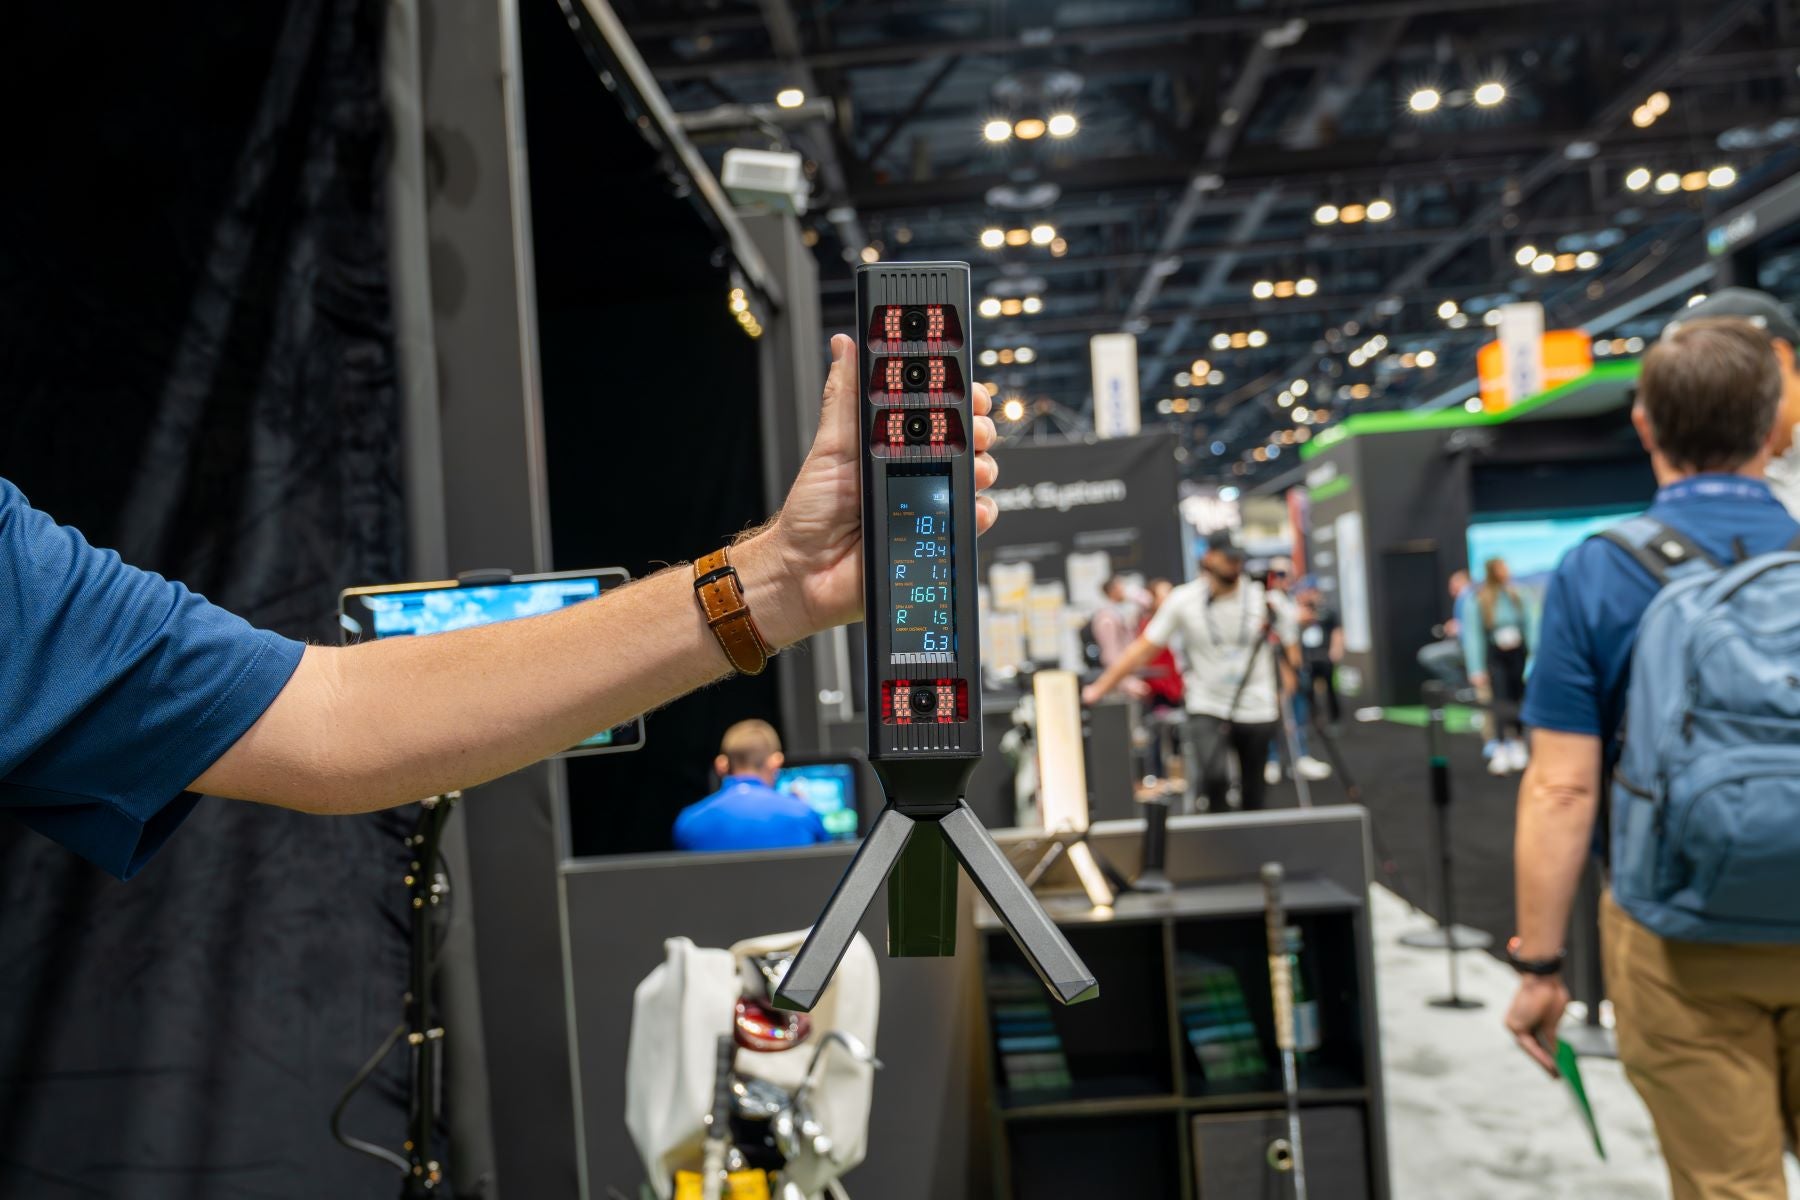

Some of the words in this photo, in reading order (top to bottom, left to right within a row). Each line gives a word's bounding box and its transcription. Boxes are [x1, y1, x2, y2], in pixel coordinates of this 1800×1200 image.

[1033, 479, 1127, 512] System
[916, 516, 945, 535] 18.1
[914, 541, 946, 558] 29.4
[895, 564, 906, 579] R
[932, 564, 947, 579] 1.1
[910, 586, 947, 603] 1667
[896, 609, 907, 625] R
[933, 609, 948, 625] 1.5
[923, 631, 949, 651] 6.3
